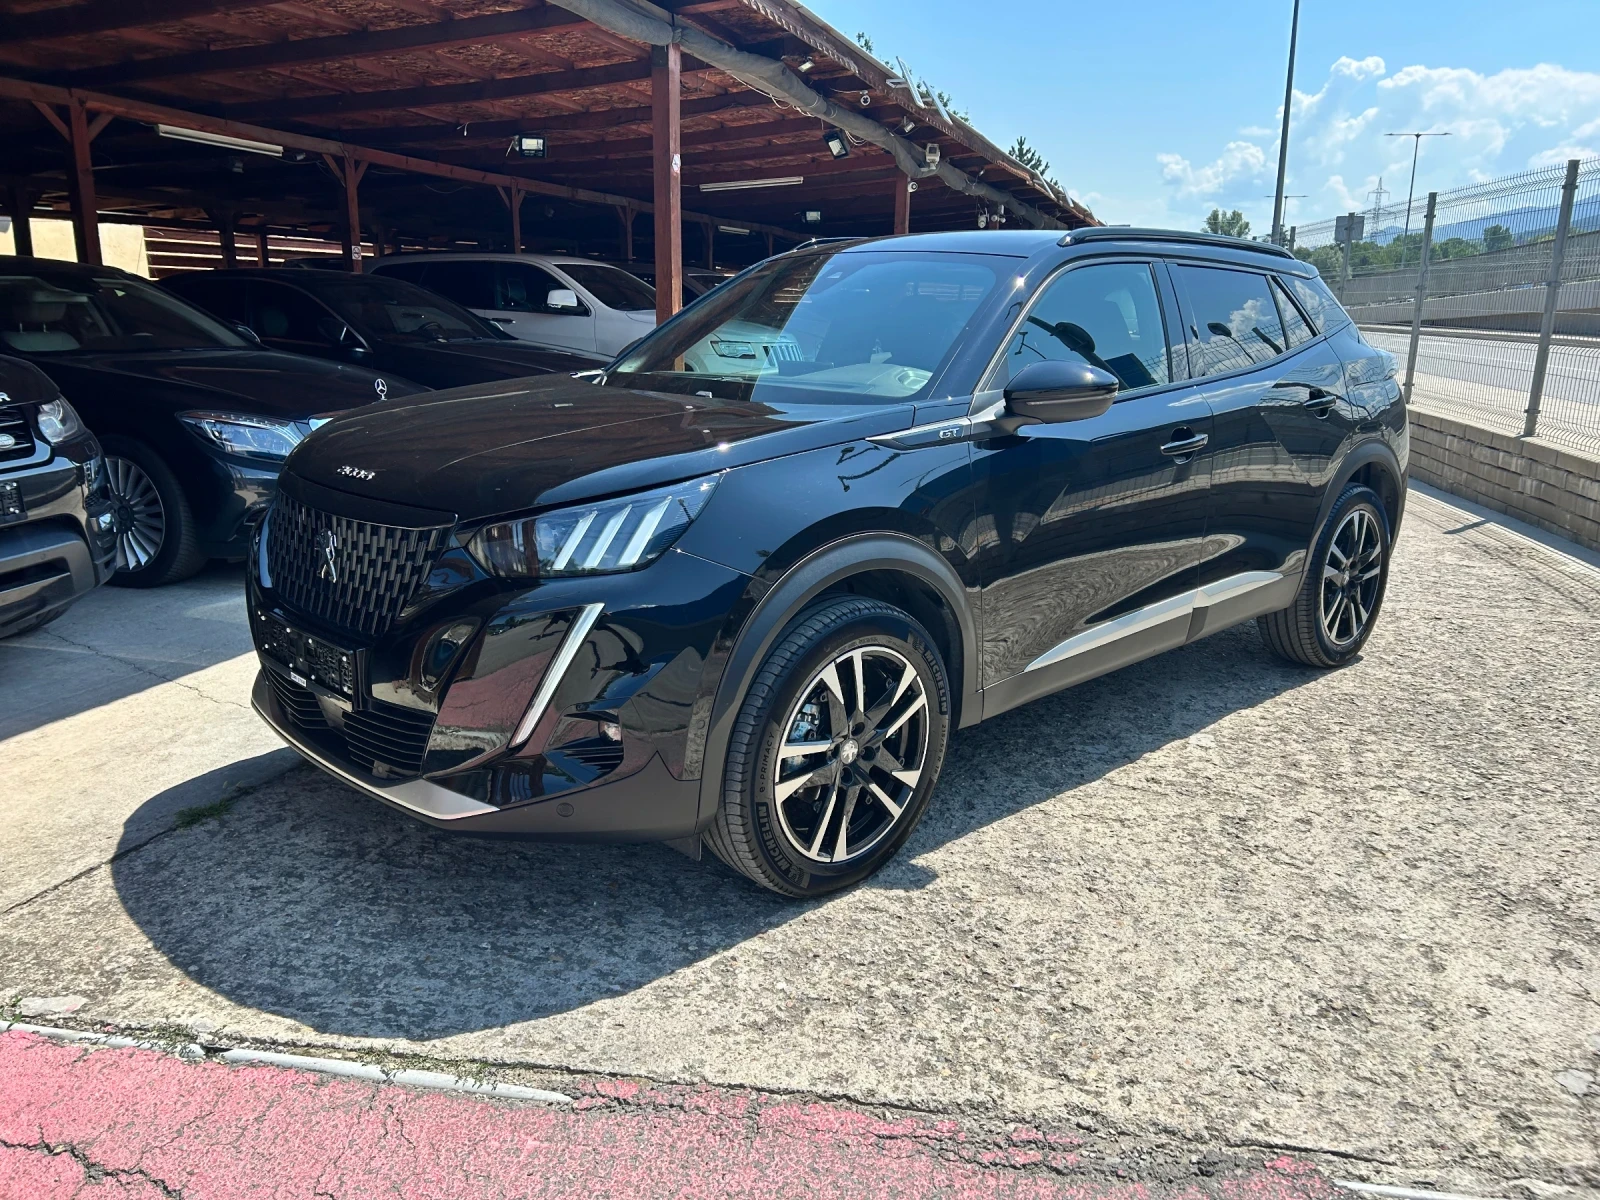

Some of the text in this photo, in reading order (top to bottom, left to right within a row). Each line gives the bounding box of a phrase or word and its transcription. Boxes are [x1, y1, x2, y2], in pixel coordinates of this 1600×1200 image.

[939, 427, 960, 439] GT
[924, 649, 948, 713] MICHELIN
[758, 805, 791, 871] MICHELIN
